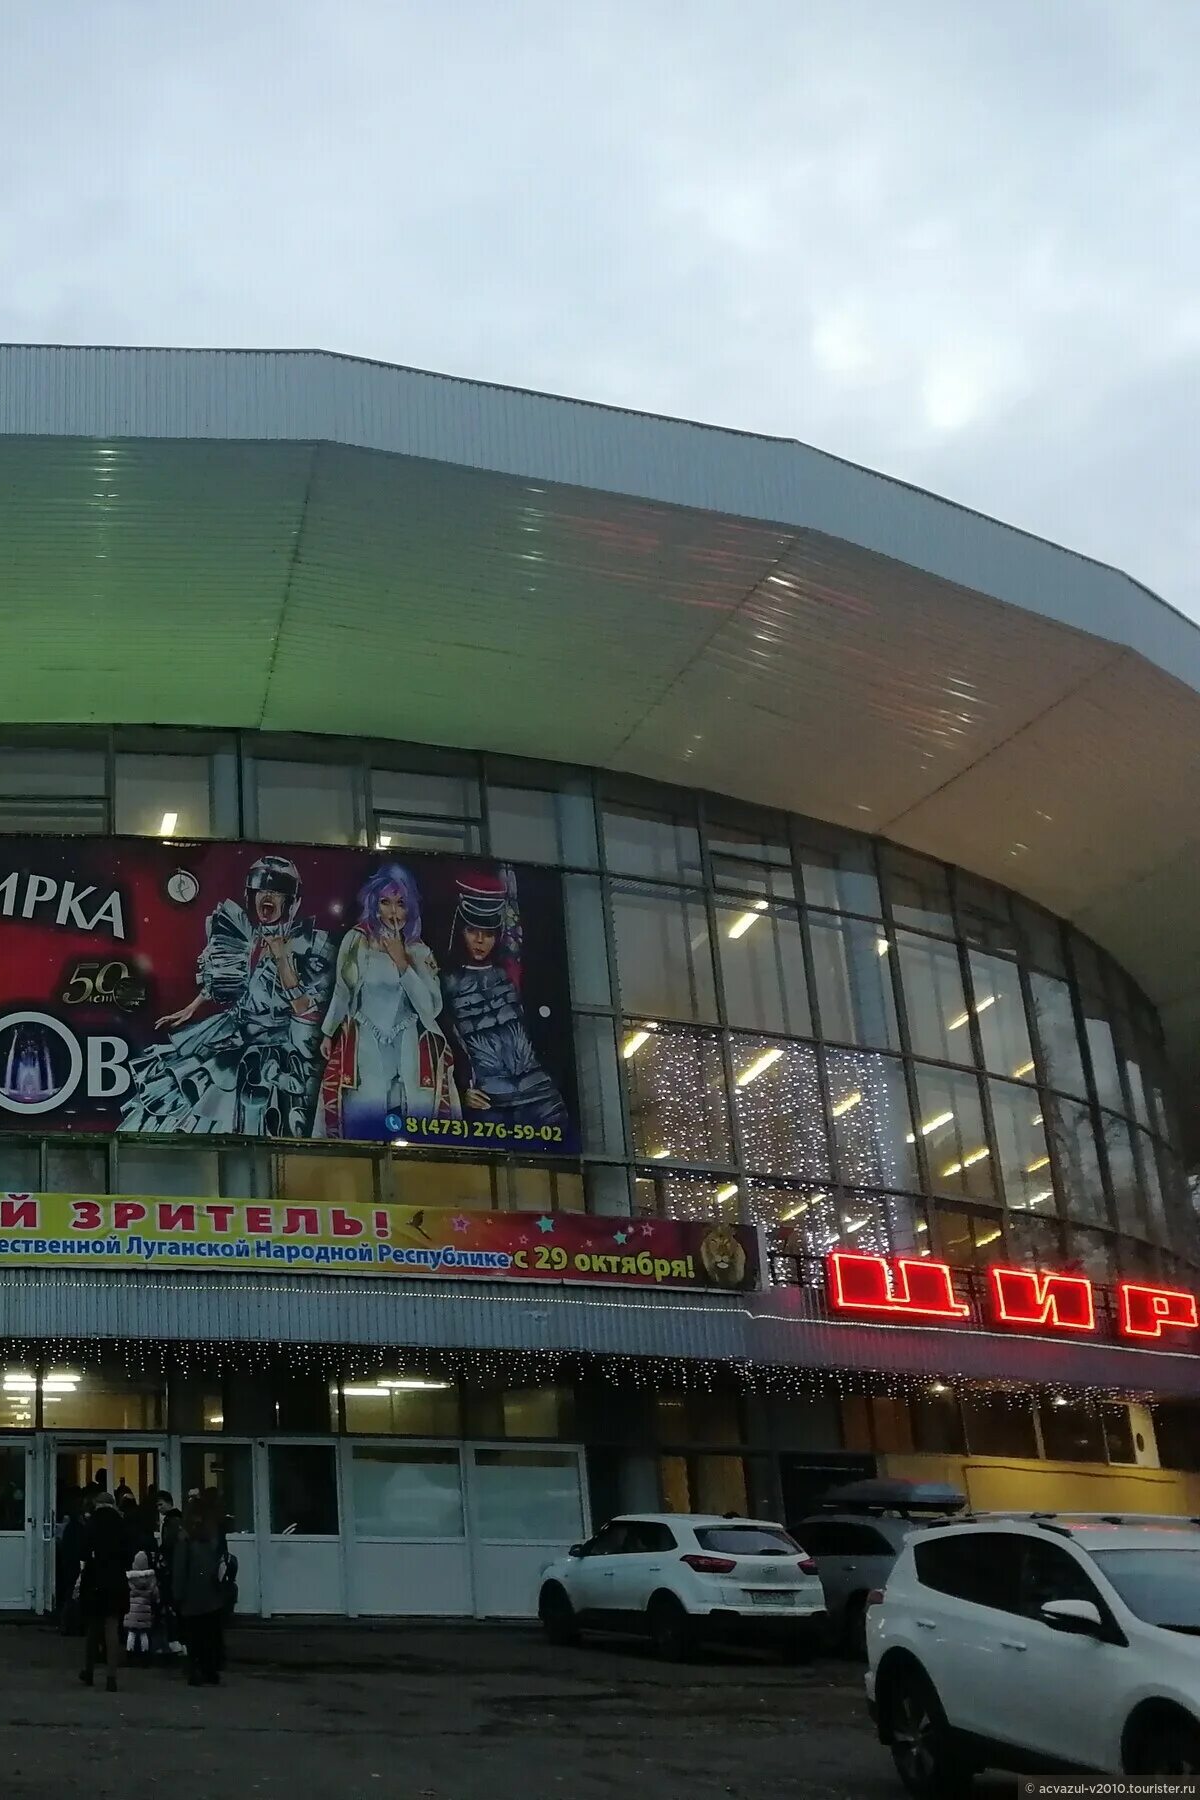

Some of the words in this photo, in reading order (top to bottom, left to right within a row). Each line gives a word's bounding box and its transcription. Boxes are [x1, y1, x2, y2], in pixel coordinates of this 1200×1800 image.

[406, 1117, 418, 1133] 8
[422, 1118, 469, 1138] (473)
[473, 1121, 563, 1142] 276-59-02
[71, 1200, 390, 1237] ЗРИТЕЛЬ!
[126, 1237, 251, 1259] Луганской
[256, 1240, 373, 1263] Народной
[379, 1244, 510, 1269] Республике
[514, 1250, 528, 1268] с
[534, 1246, 568, 1271] 29
[576, 1251, 696, 1284] октября!
